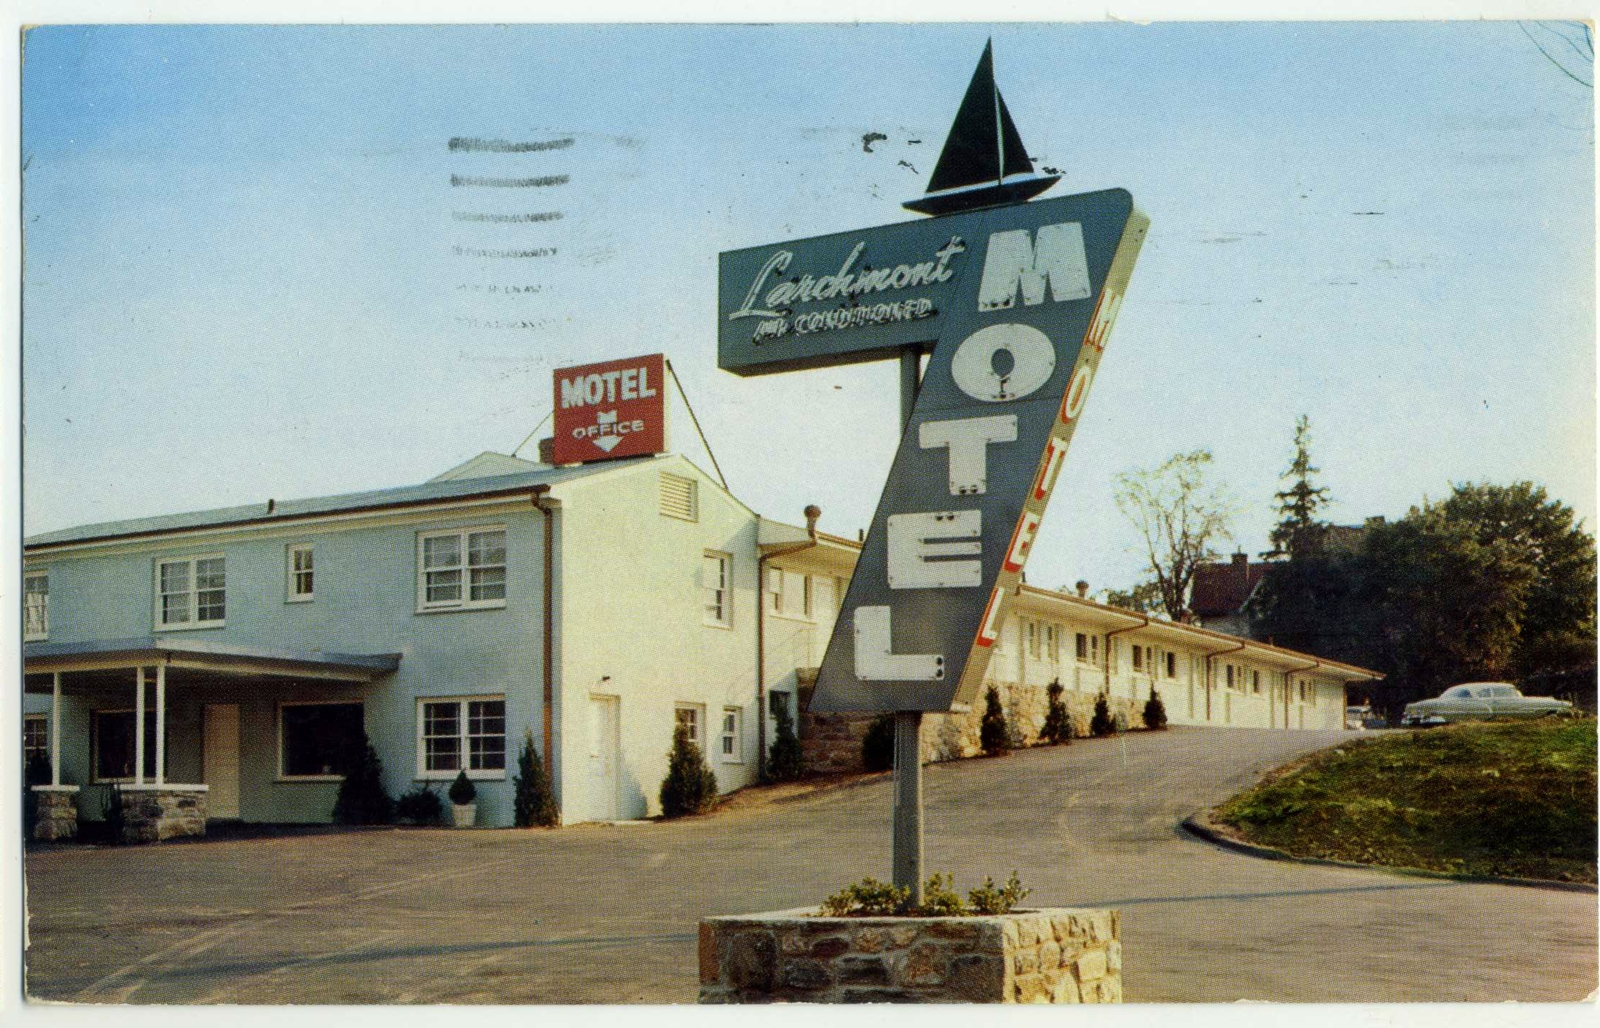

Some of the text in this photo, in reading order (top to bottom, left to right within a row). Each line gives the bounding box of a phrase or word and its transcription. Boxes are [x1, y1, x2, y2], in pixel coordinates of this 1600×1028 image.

[729, 236, 966, 320] Larchmont
[561, 367, 656, 409] MOTEL
[572, 419, 644, 440] OFFICE
[854, 221, 1091, 681] MOTEL
[977, 287, 1121, 647] MOTEL
